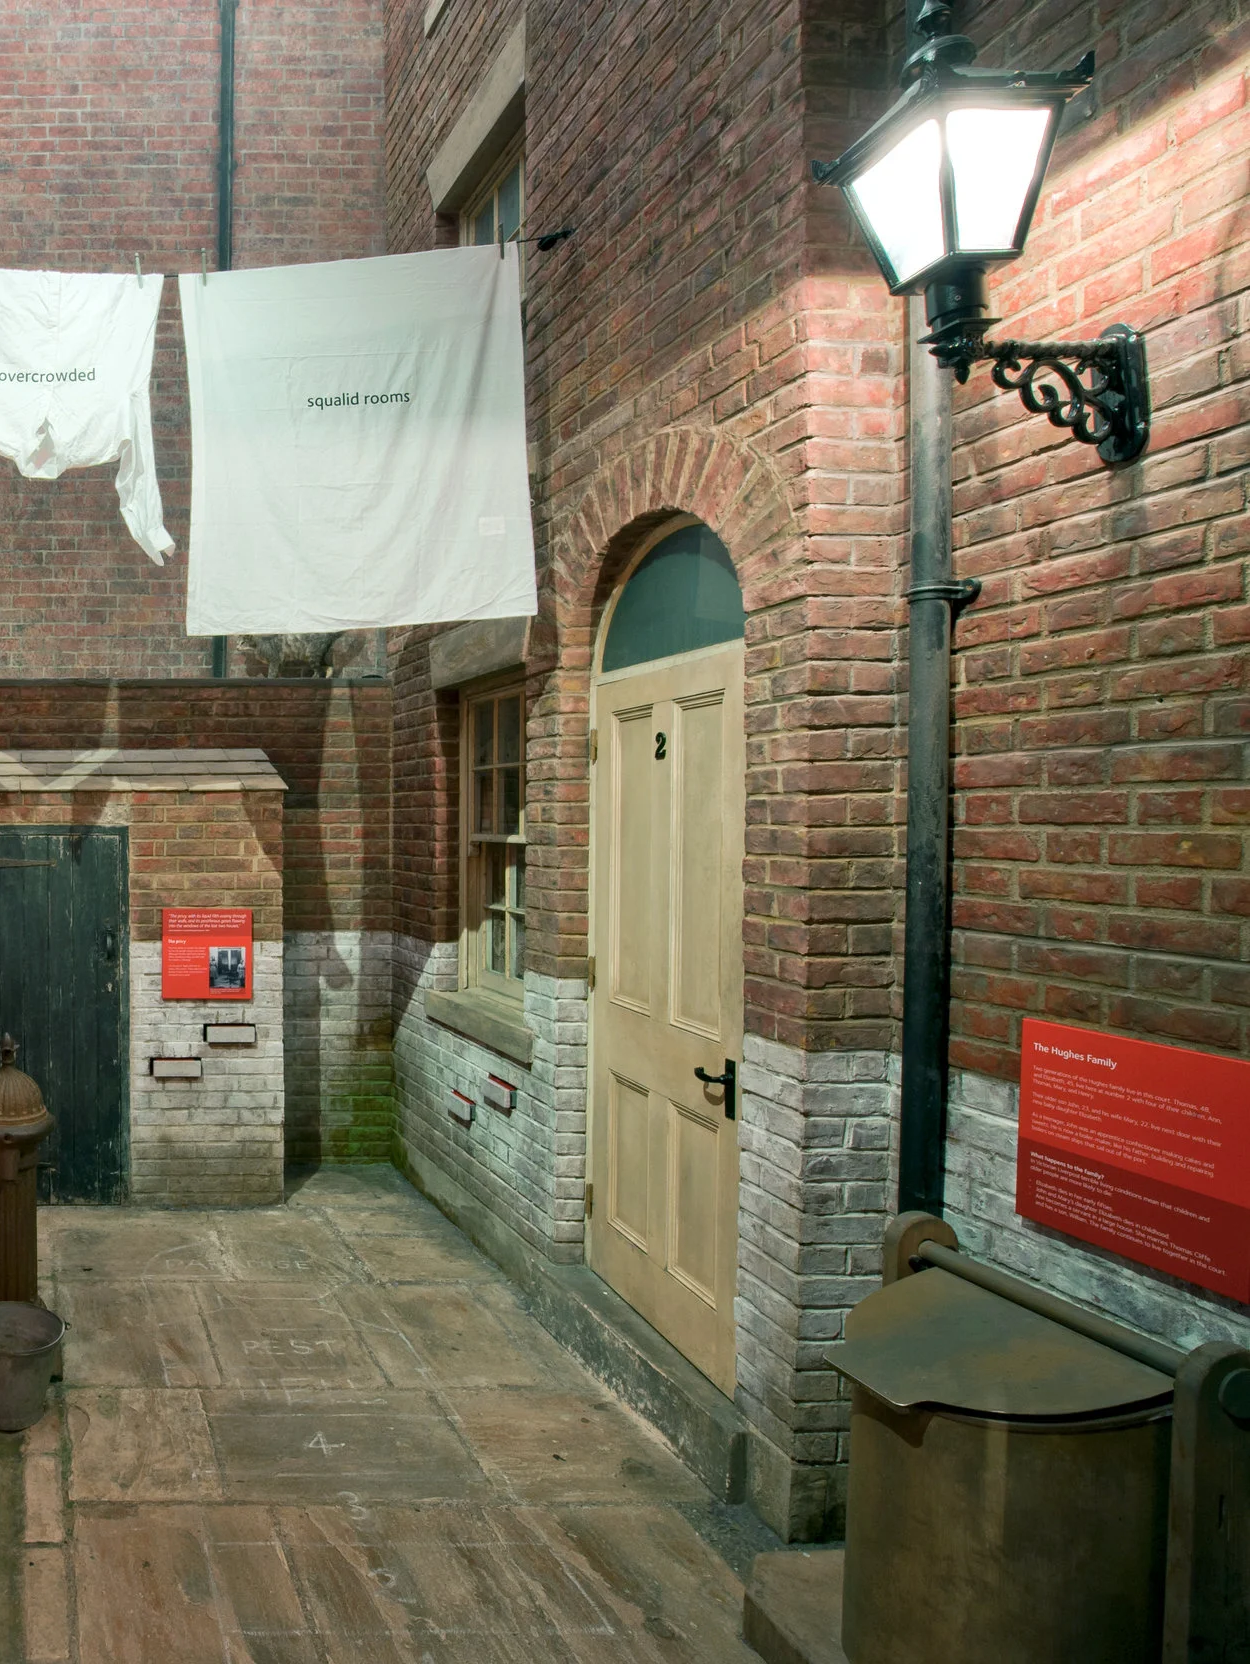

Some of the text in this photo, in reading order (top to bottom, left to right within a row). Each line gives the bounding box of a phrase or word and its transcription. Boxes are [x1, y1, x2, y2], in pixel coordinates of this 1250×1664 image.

[307, 392, 410, 410] squalid rooms
[654, 732, 666, 760] 2
[1034, 1043, 1118, 1071] The Hughes Family
[1207, 1139, 1222, 1148] their
[1031, 1152, 1044, 1160] What
[1045, 1156, 1066, 1168] happens
[1084, 1169, 1104, 1181] family?
[304, 1430, 346, 1456] 4
